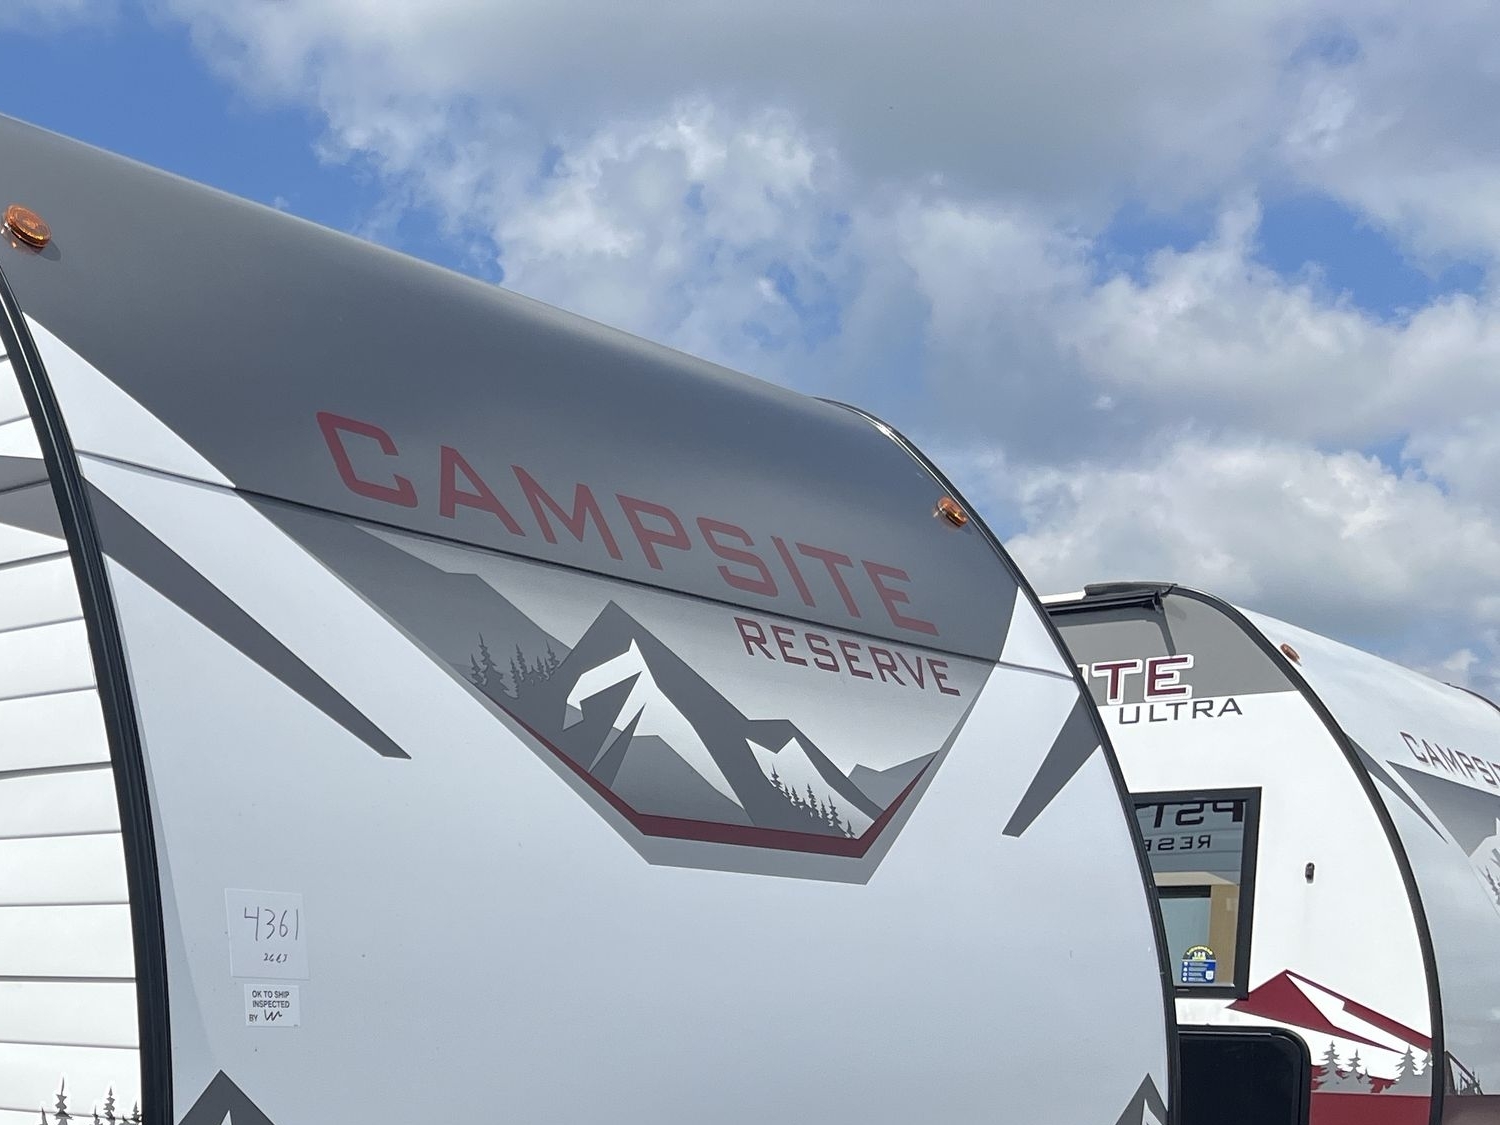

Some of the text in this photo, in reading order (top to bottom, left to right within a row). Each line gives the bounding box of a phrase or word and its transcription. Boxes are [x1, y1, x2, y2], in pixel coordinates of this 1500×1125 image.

[316, 411, 940, 635] CAMPSITE
[733, 616, 961, 696] RESERVE
[1077, 655, 1192, 703] TE
[1118, 697, 1243, 725] ULTRA
[243, 906, 299, 941] 4361
[252, 990, 290, 1000] OK TO SHIP
[252, 1000, 290, 1009] INSPECTED
